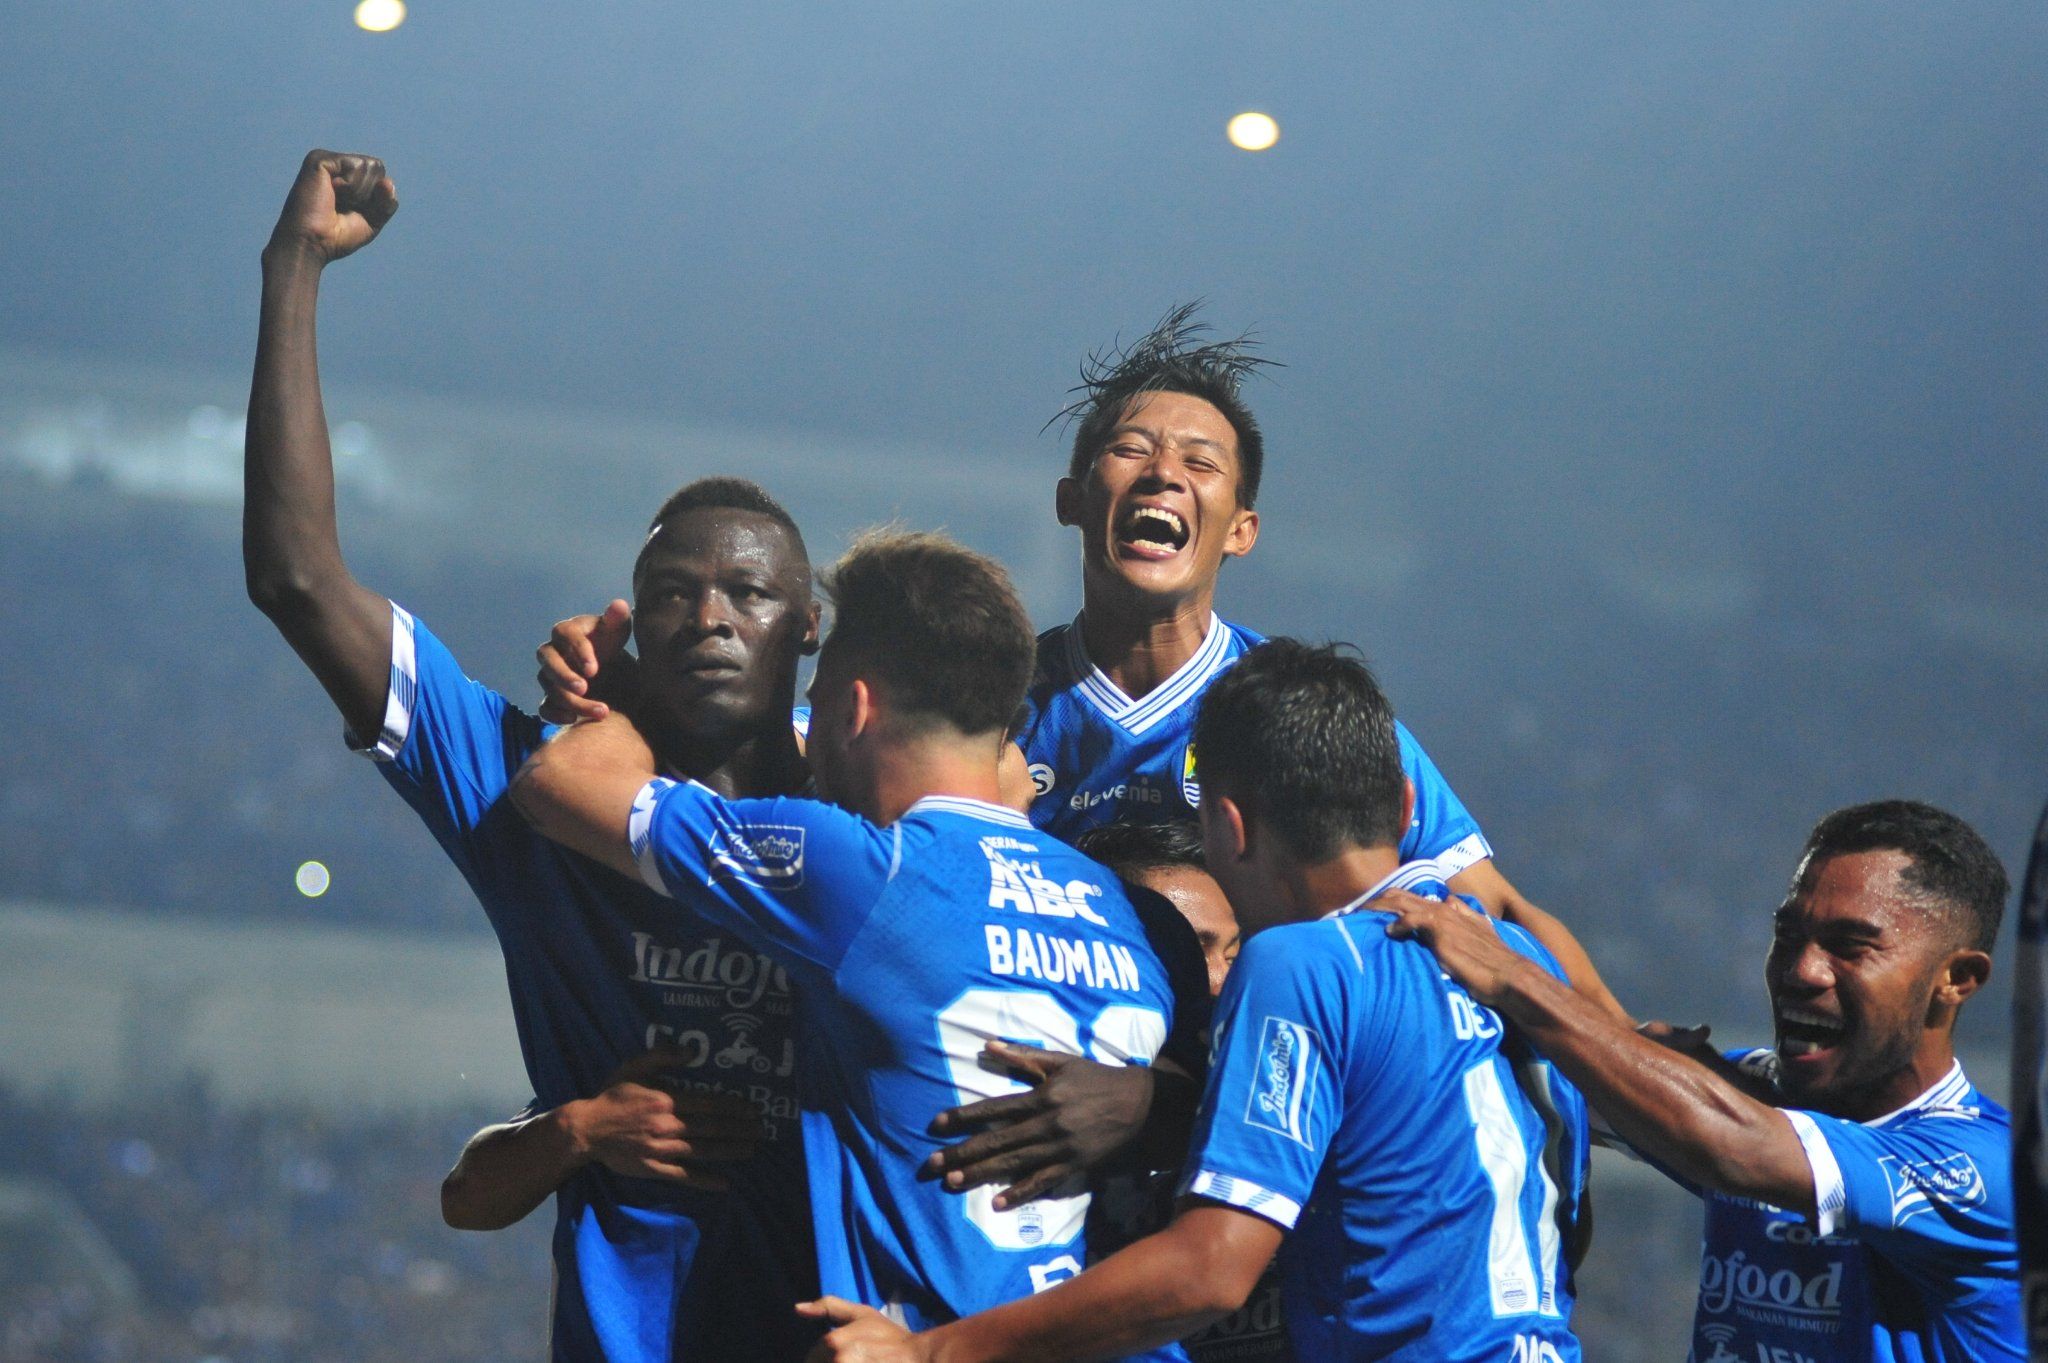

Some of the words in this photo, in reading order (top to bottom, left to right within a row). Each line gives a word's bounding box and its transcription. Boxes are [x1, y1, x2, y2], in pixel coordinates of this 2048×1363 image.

[1070, 777, 1162, 811] elevenia
[988, 860, 1110, 928] ABC
[984, 924, 1141, 992] BAUMAN
